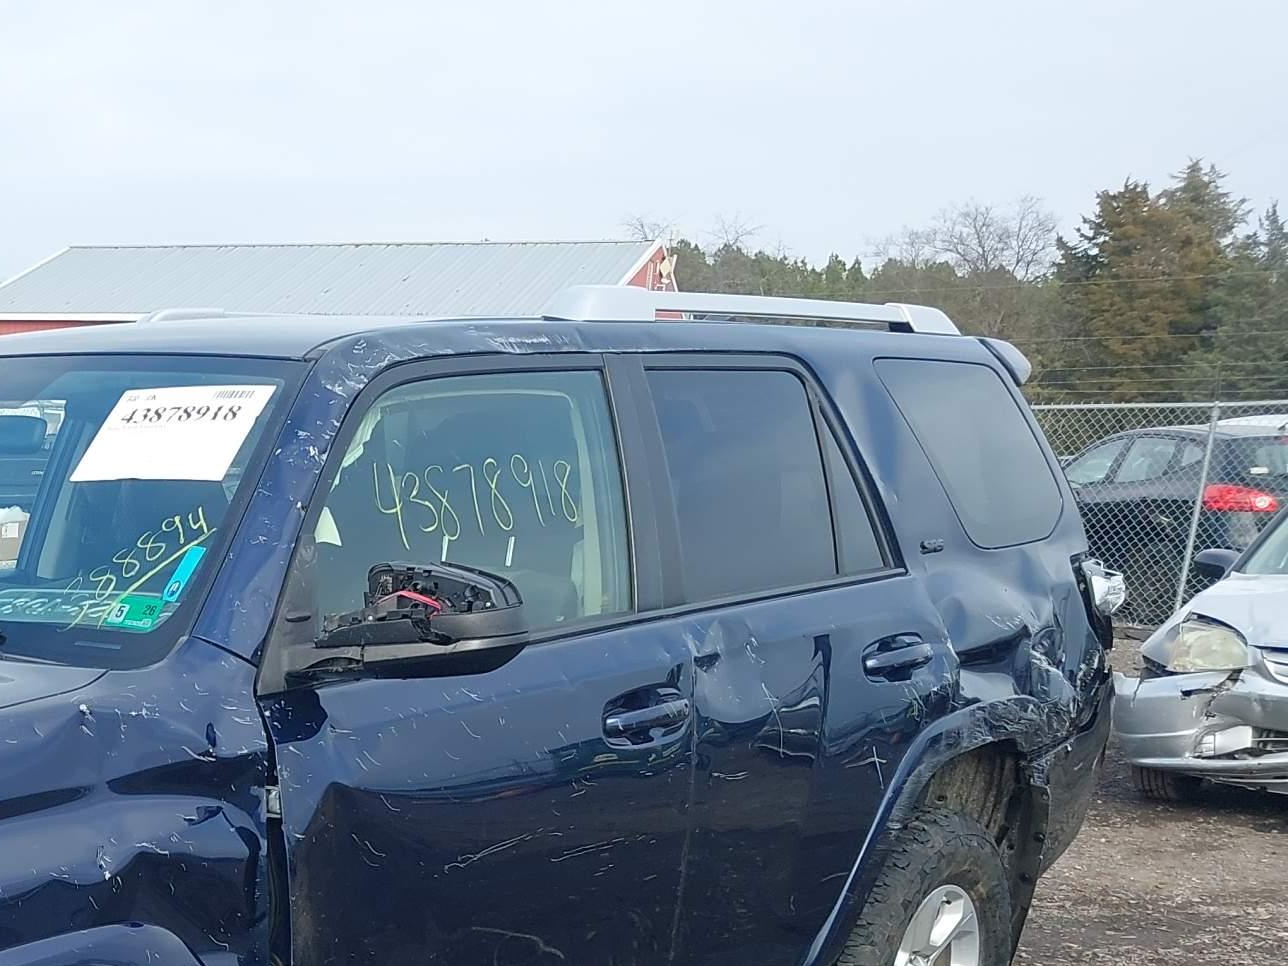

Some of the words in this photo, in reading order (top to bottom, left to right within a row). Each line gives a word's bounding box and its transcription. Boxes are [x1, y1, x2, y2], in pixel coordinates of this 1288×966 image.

[121, 404, 243, 424] 43878918
[372, 454, 579, 551] 43878918
[115, 605, 126, 618] 5
[142, 604, 158, 616] 26
